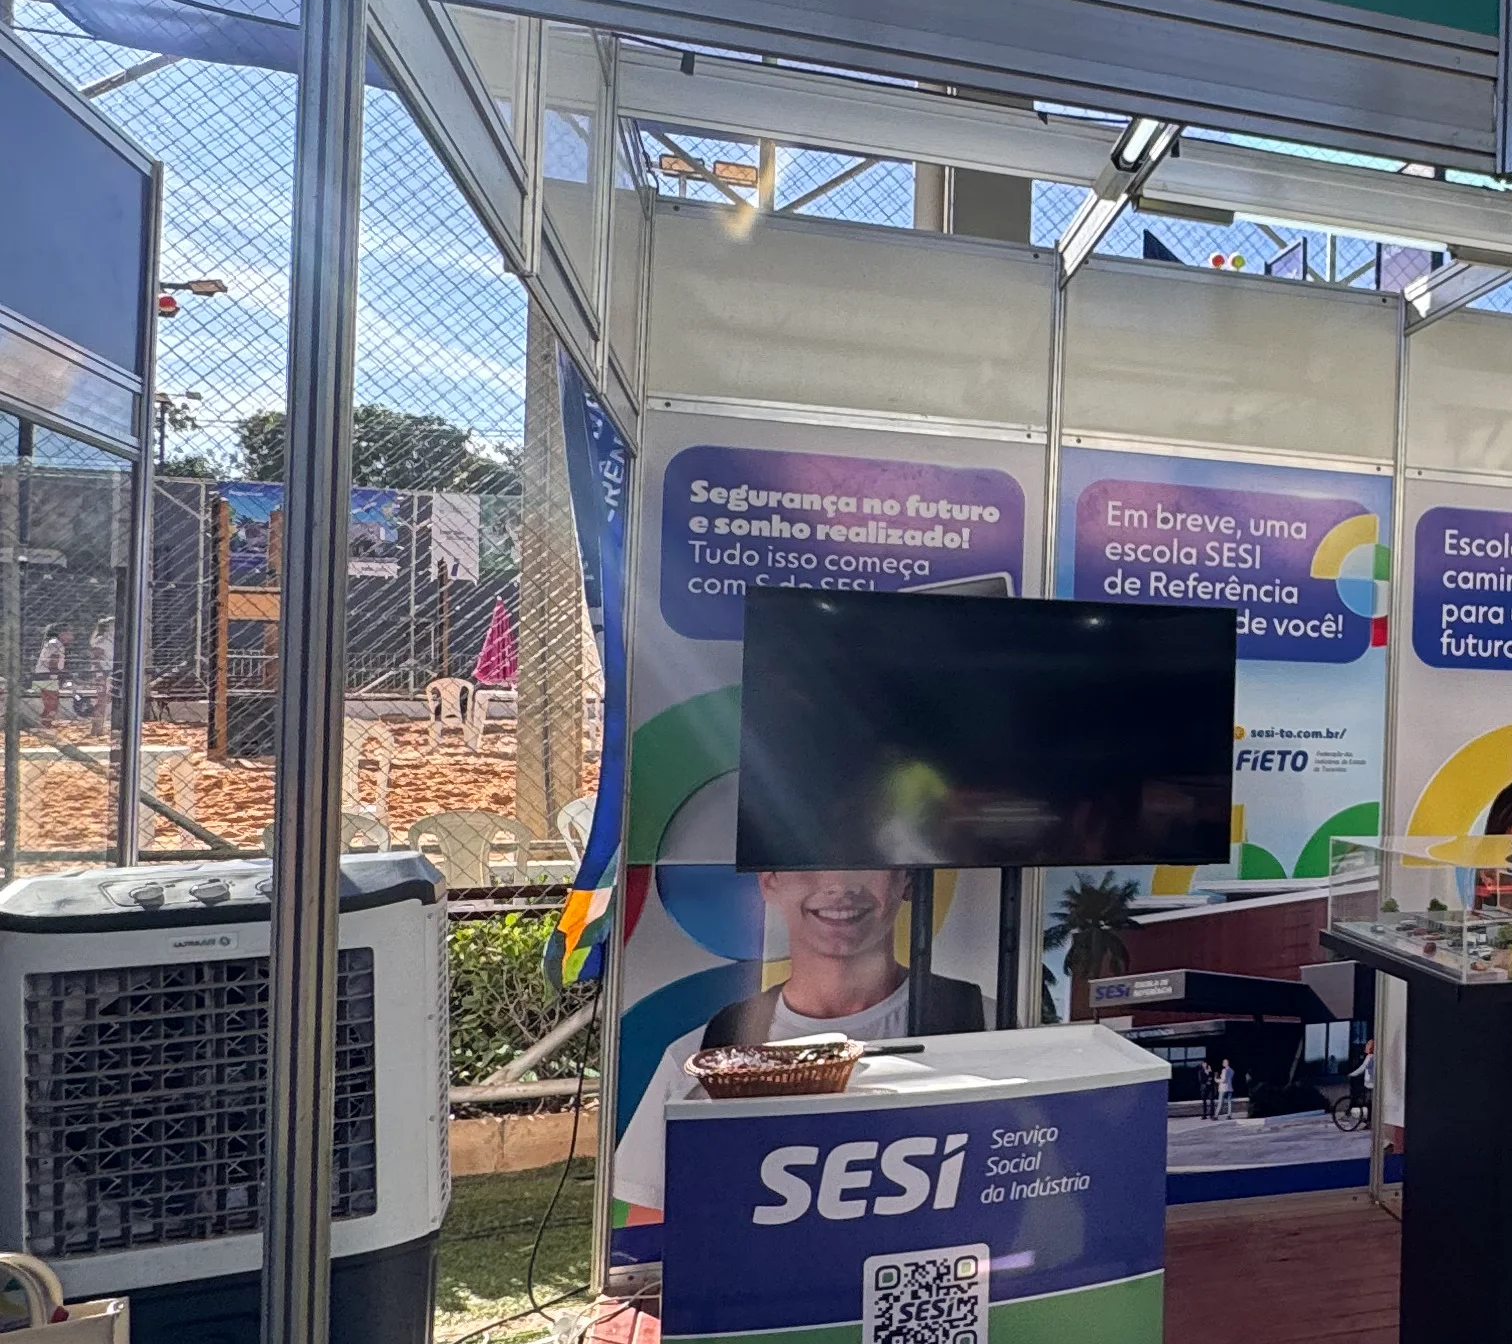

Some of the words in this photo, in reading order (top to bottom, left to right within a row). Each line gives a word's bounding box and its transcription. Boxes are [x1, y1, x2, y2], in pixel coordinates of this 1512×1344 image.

[690, 479, 857, 517] Segurança
[863, 497, 902, 517] no
[906, 494, 1001, 524] futuro
[688, 516, 709, 534] e
[714, 514, 811, 540] sonho
[816, 520, 971, 550] realizado!
[1106, 500, 1148, 529] Em
[1156, 503, 1242, 540] breve,
[1249, 517, 1308, 540] uma
[688, 540, 760, 567] Tudo
[767, 545, 818, 570] isso
[824, 557, 930, 581] começa
[1104, 538, 1198, 566] escola
[1204, 541, 1261, 570] SESI
[688, 576, 747, 596] com
[1103, 568, 1142, 596] de
[1149, 570, 1299, 605] Referência
[1272, 613, 1344, 639] você!
[1441, 603, 1504, 629] para
[1250, 726, 1348, 740] sesi-to.com.br/
[990, 1125, 1059, 1150] Serviço
[984, 1151, 1042, 1177] Social
[980, 1184, 1006, 1205] da
[1010, 1172, 1091, 1202] Indústria
